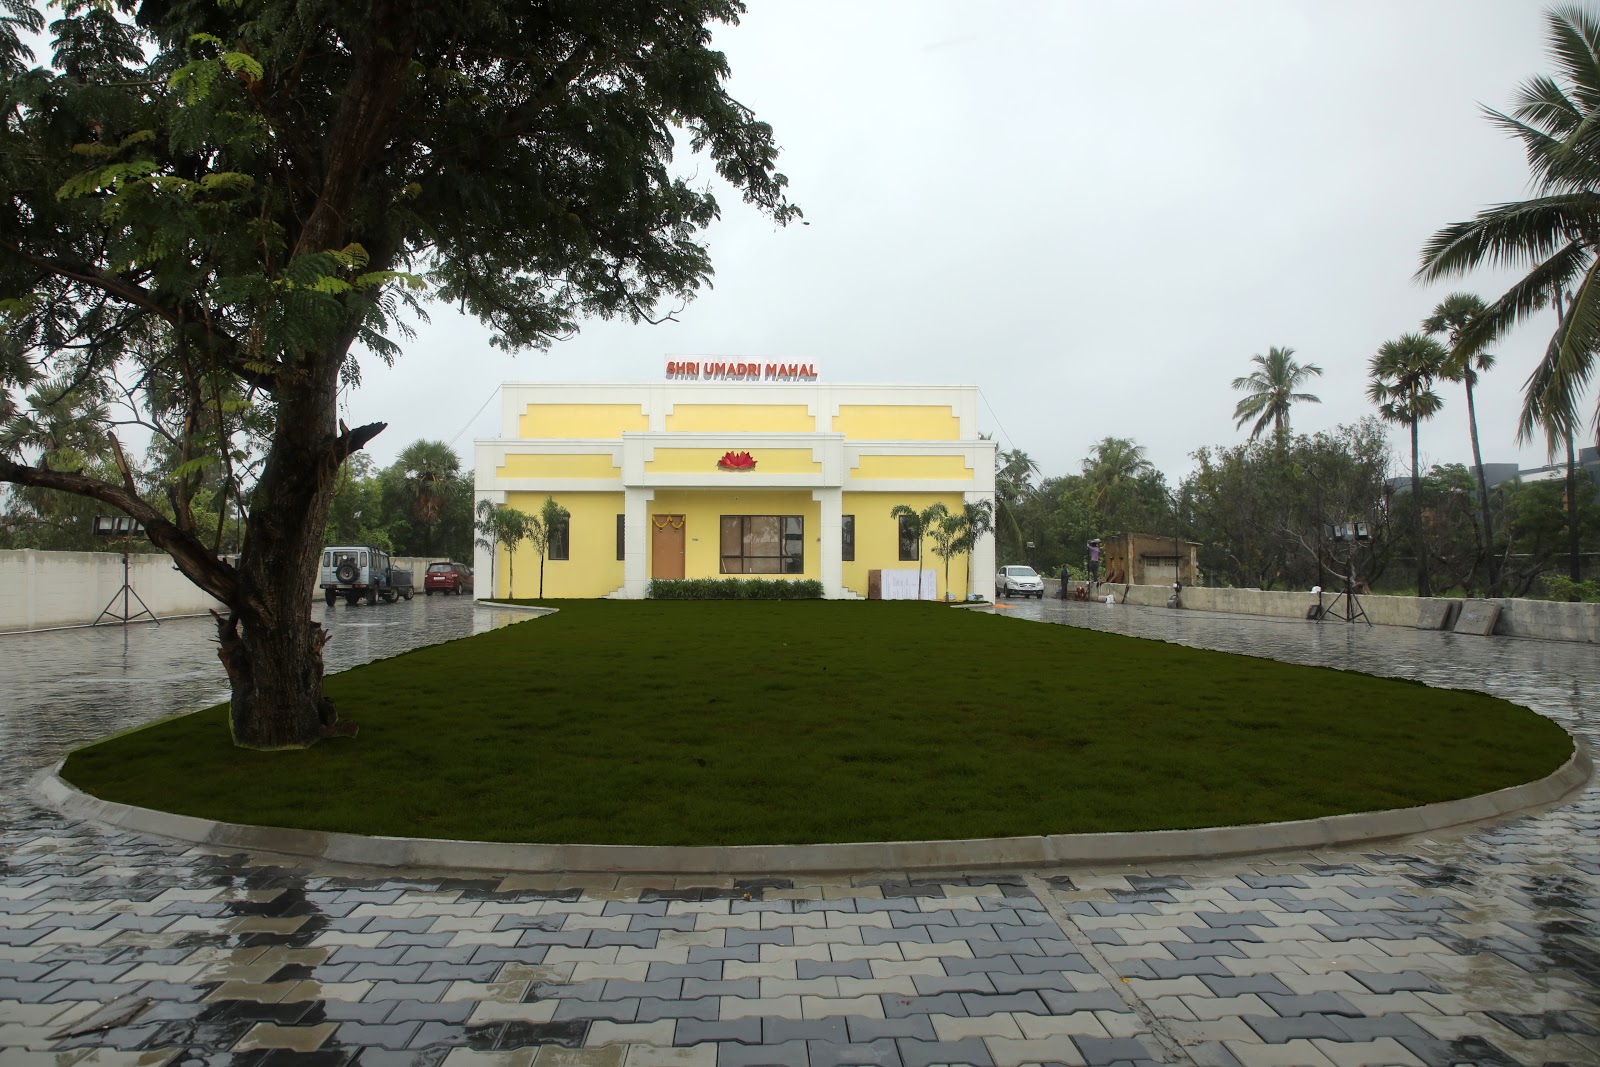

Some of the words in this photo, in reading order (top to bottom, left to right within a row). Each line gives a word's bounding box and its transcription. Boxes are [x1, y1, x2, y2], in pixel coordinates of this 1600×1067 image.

[666, 361, 700, 377] SHRI
[703, 362, 761, 378] UMADRI
[764, 363, 818, 379] MAHAL
